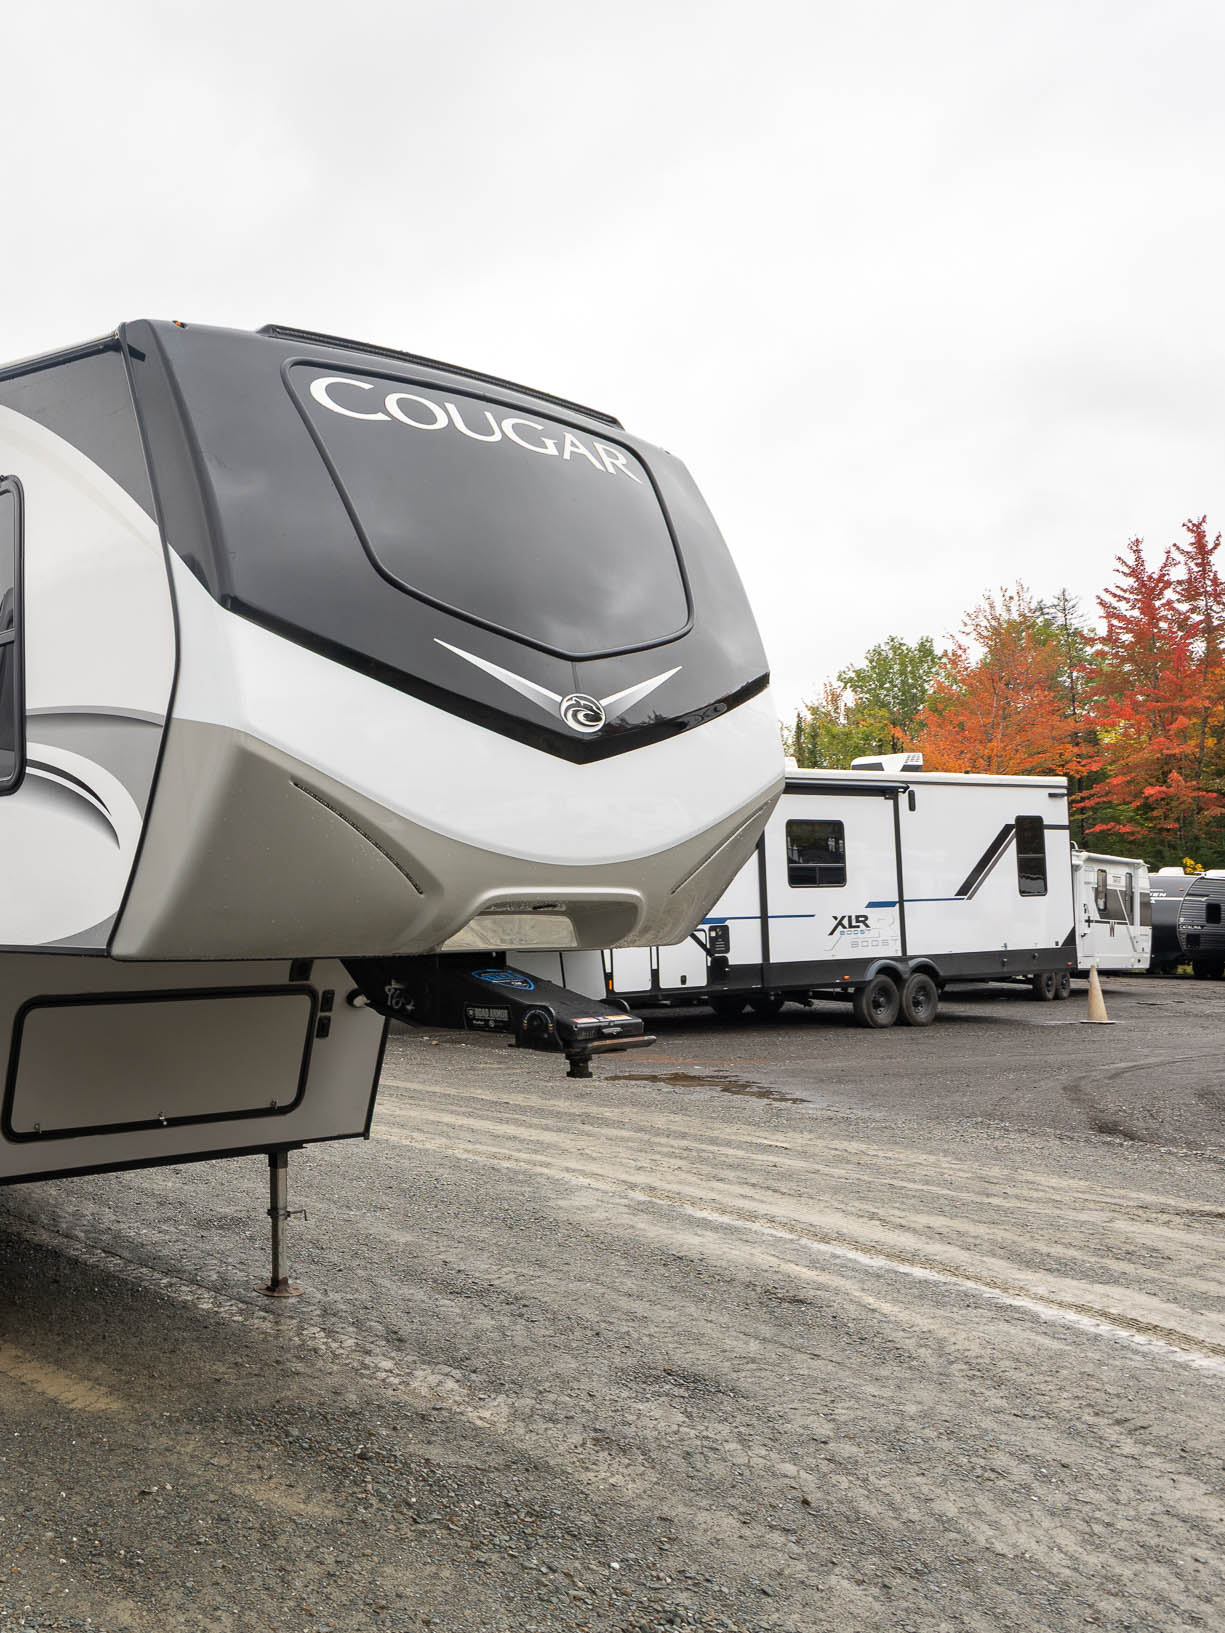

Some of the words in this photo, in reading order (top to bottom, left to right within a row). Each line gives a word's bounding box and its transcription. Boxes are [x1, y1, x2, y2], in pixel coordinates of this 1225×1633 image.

[309, 376, 643, 485] COUGAR
[827, 914, 872, 936] XLR
[850, 935, 900, 948] BOOST
